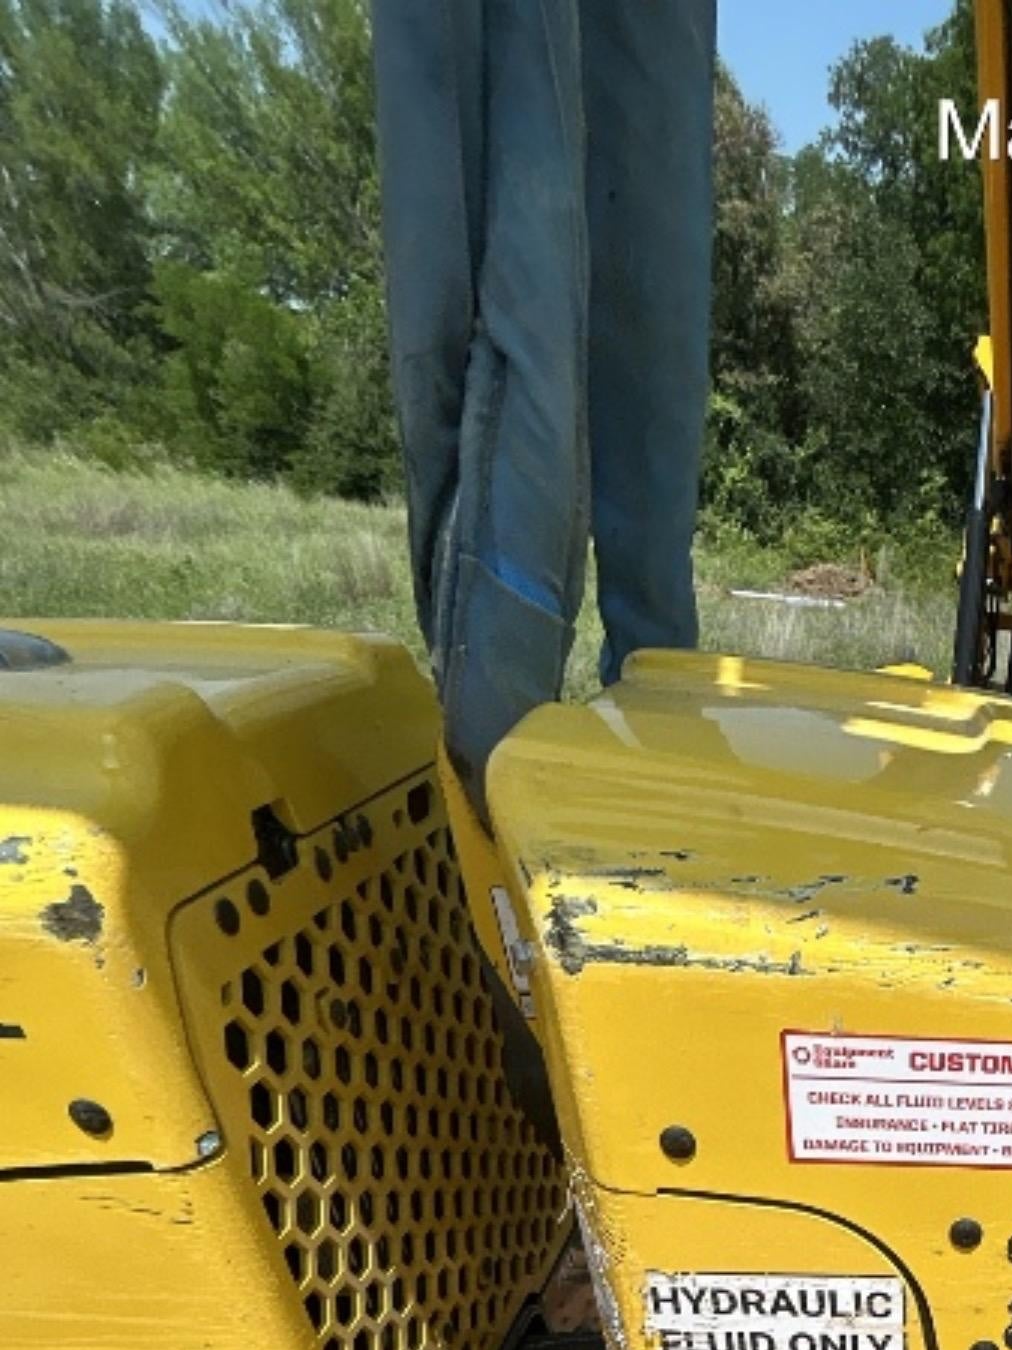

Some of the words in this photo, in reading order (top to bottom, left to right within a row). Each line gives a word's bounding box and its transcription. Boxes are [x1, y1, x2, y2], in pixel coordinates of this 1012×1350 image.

[806, 1091, 862, 1107] CHECK
[865, 1094, 893, 1108] ALL
[896, 1095, 944, 1109] FLUID
[947, 1097, 1005, 1112] LEVELS
[940, 1120, 979, 1135] FLAT
[802, 1139, 870, 1153] DAMAGE
[872, 1140, 893, 1154] TO
[896, 1141, 990, 1157] EQUIPMENT
[650, 1286, 893, 1319] HYDRAULIC
